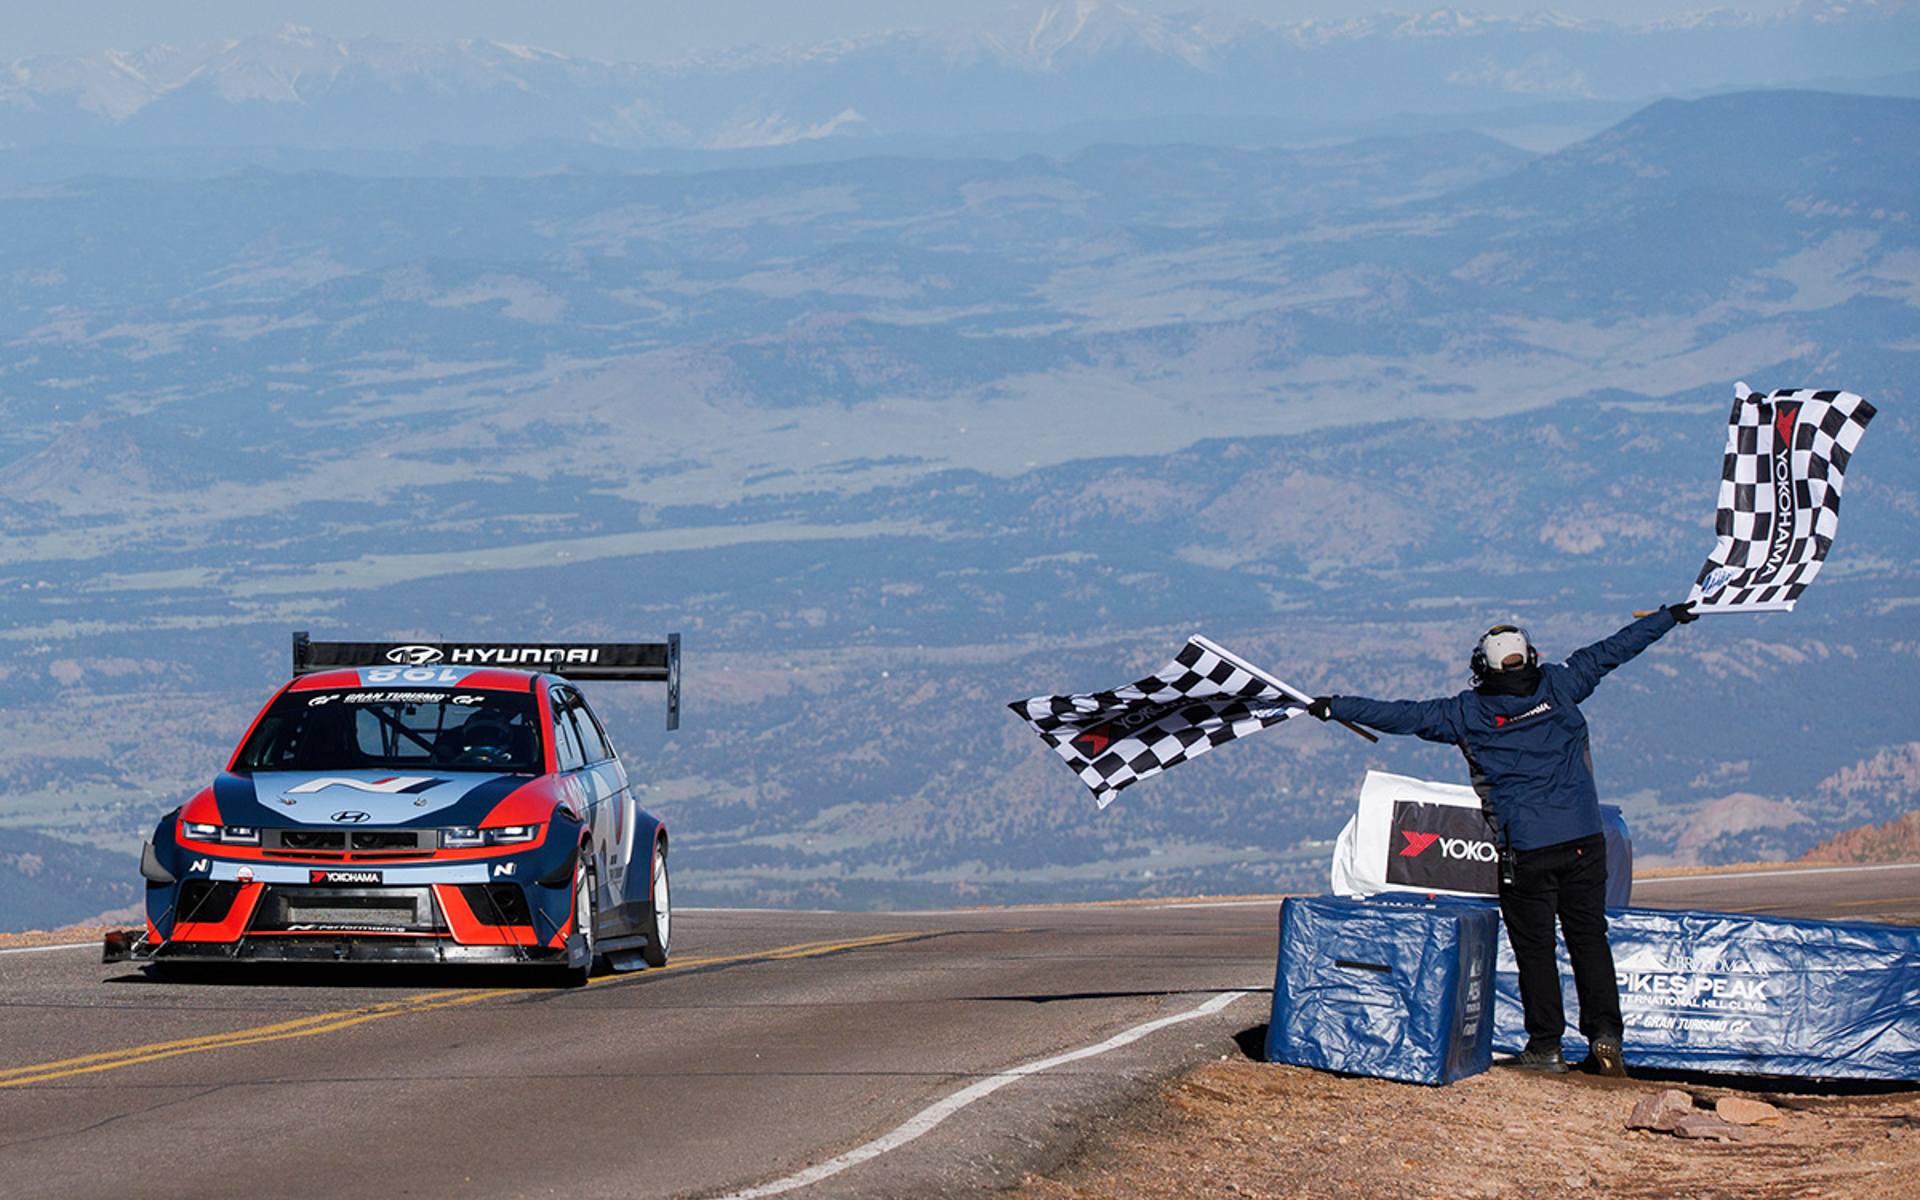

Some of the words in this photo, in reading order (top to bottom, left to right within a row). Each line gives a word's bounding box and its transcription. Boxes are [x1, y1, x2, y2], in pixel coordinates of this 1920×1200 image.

[1760, 449, 1792, 578] YOKOHAMA
[452, 648, 600, 662] HYUNDAI
[367, 668, 458, 682] 198
[344, 692, 386, 702] GRAN
[386, 692, 445, 702] TURISMO
[1438, 837, 1499, 863] YOKO
[326, 871, 380, 883] YOKOHAMA
[318, 924, 406, 932] Performance
[1616, 973, 1687, 995] PIKES
[1695, 977, 1768, 1000] PEAK
[1620, 993, 1700, 1008] TERNATIONAL
[1702, 999, 1727, 1010] HILL
[1728, 1000, 1768, 1012] CLIMB
[1643, 1015, 1676, 1029] GRAN
[1677, 1018, 1728, 1033] TURISMO
